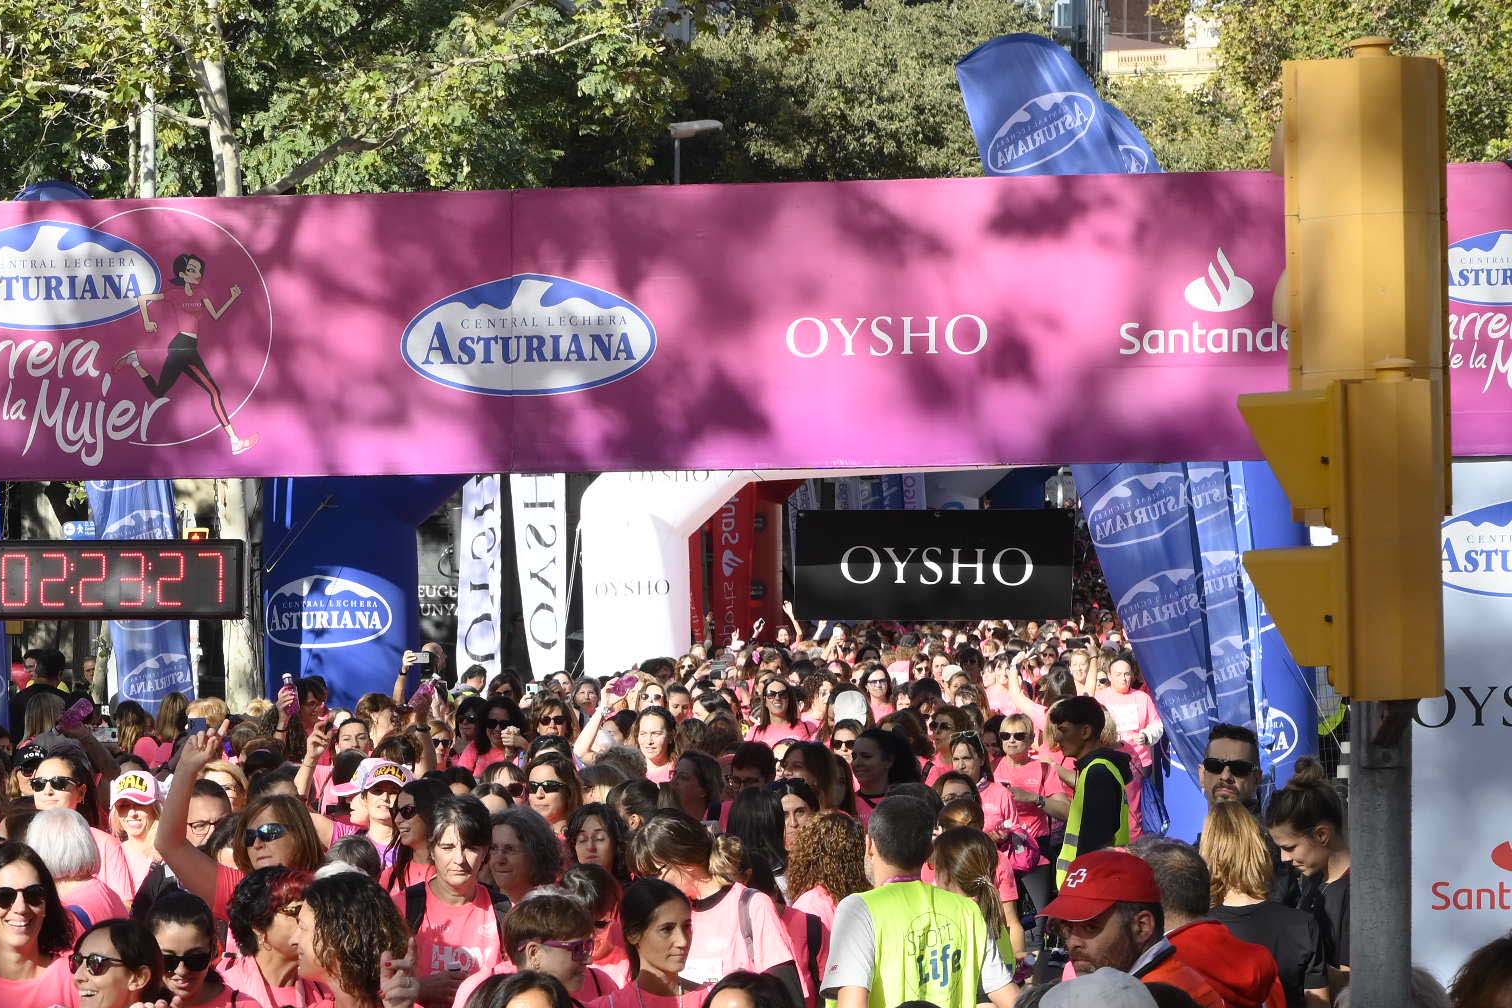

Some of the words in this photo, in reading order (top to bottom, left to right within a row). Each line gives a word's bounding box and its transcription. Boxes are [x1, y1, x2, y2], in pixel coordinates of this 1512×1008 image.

[64, 257, 136, 269] LECHERA
[460, 315, 539, 330] CENTRAL
[547, 314, 628, 328] LECHERA
[785, 314, 989, 359] OYSHO
[1449, 311, 1512, 341] arre
[421, 322, 636, 366] ASTURIANA
[1119, 322, 1289, 355] Santande
[1449, 346, 1463, 369] e
[1470, 342, 1488, 369] la
[2, 382, 27, 421] la
[22, 374, 171, 467] Mujer
[1466, 535, 1512, 545] CENT
[1, 552, 224, 606] 02:23:27
[840, 545, 1034, 587] OYSHO
[283, 600, 325, 608] CENTRAL
[330, 600, 379, 608] LECHERA
[595, 579, 670, 599] OYSHO
[270, 604, 383, 632] ASTURIANA
[918, 944, 962, 987] Life
